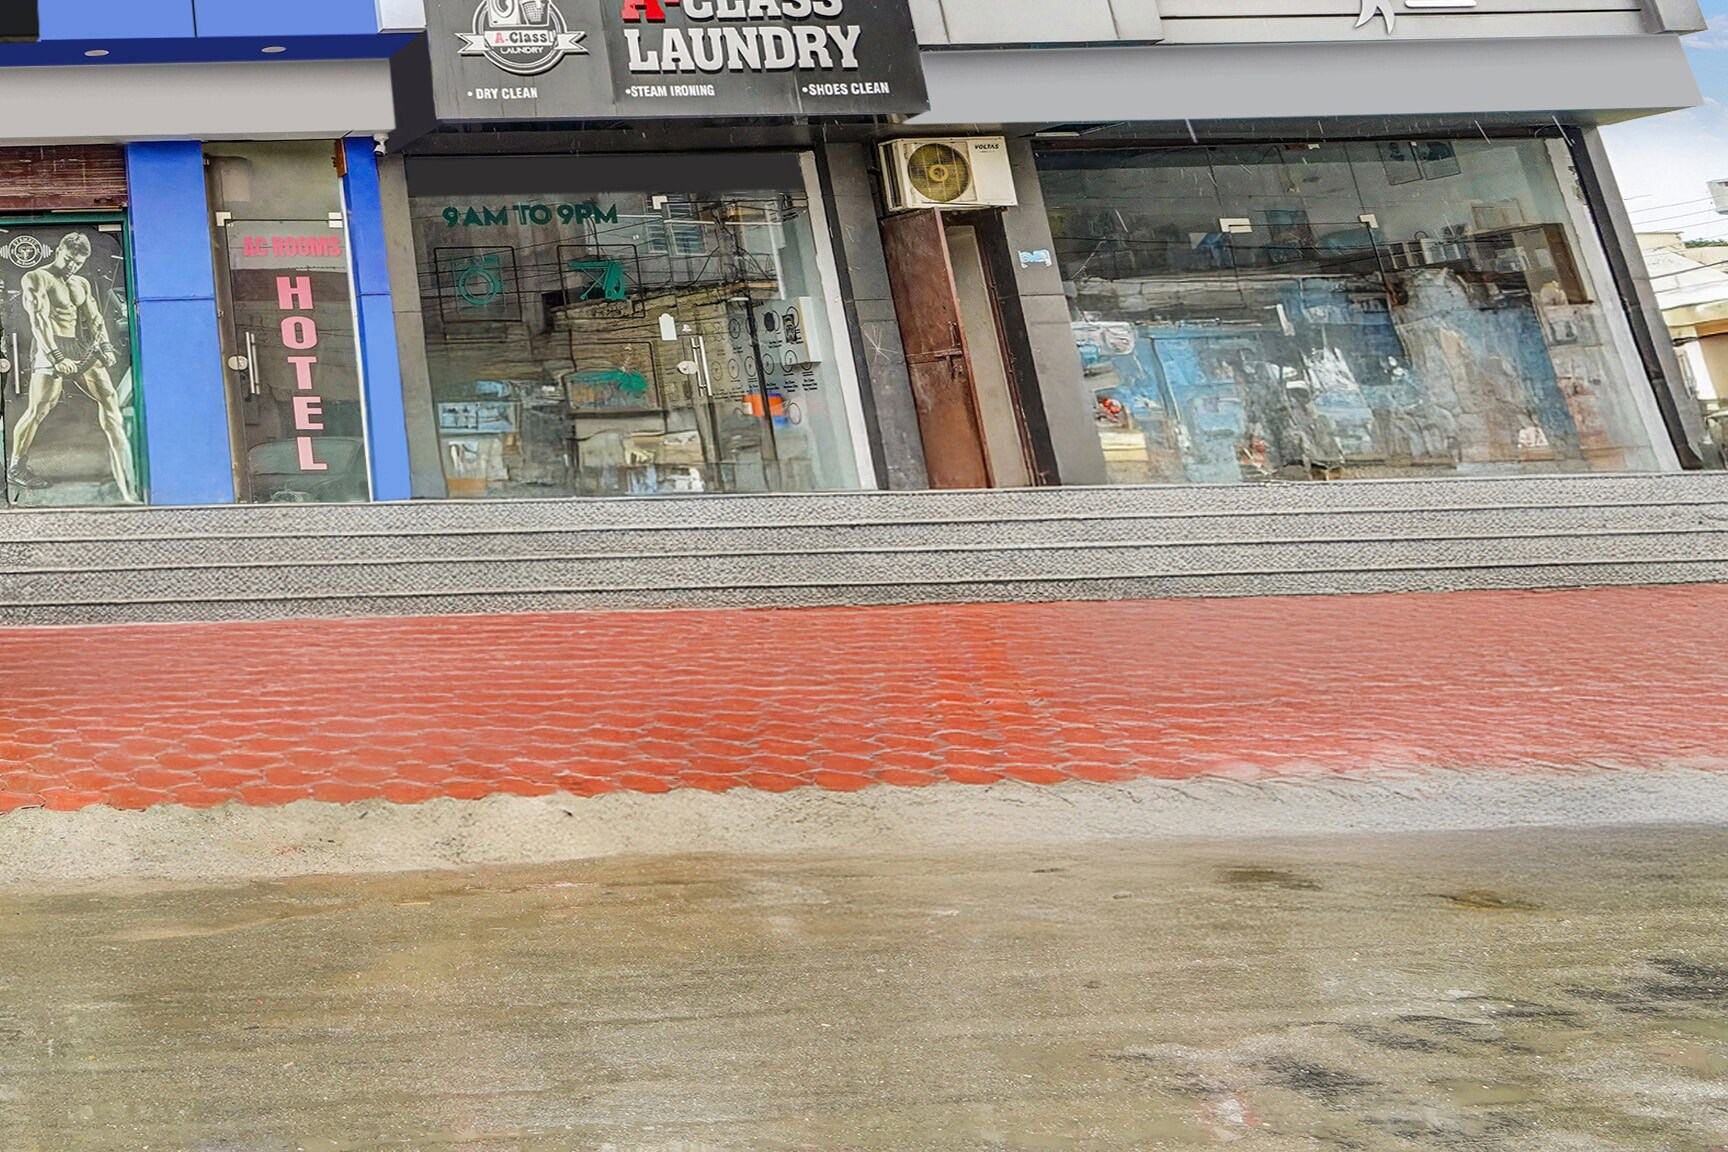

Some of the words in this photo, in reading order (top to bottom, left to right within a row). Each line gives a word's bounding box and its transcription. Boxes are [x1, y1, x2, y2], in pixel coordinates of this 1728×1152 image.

[495, 32, 548, 44] A-Class
[500, 46, 544, 55] LAUNDRY
[623, 25, 861, 74] LAUNDRY
[476, 88, 498, 99] DRY
[501, 87, 538, 99] CLEAN
[630, 85, 668, 97] STEAM
[670, 85, 715, 97] IRONING
[808, 82, 848, 96] SHOES
[851, 81, 890, 95] CLEAN
[513, 204, 553, 225] TO
[243, 236, 268, 257] AC
[272, 235, 342, 257] ROOMS
[276, 276, 328, 471] HOTEL
